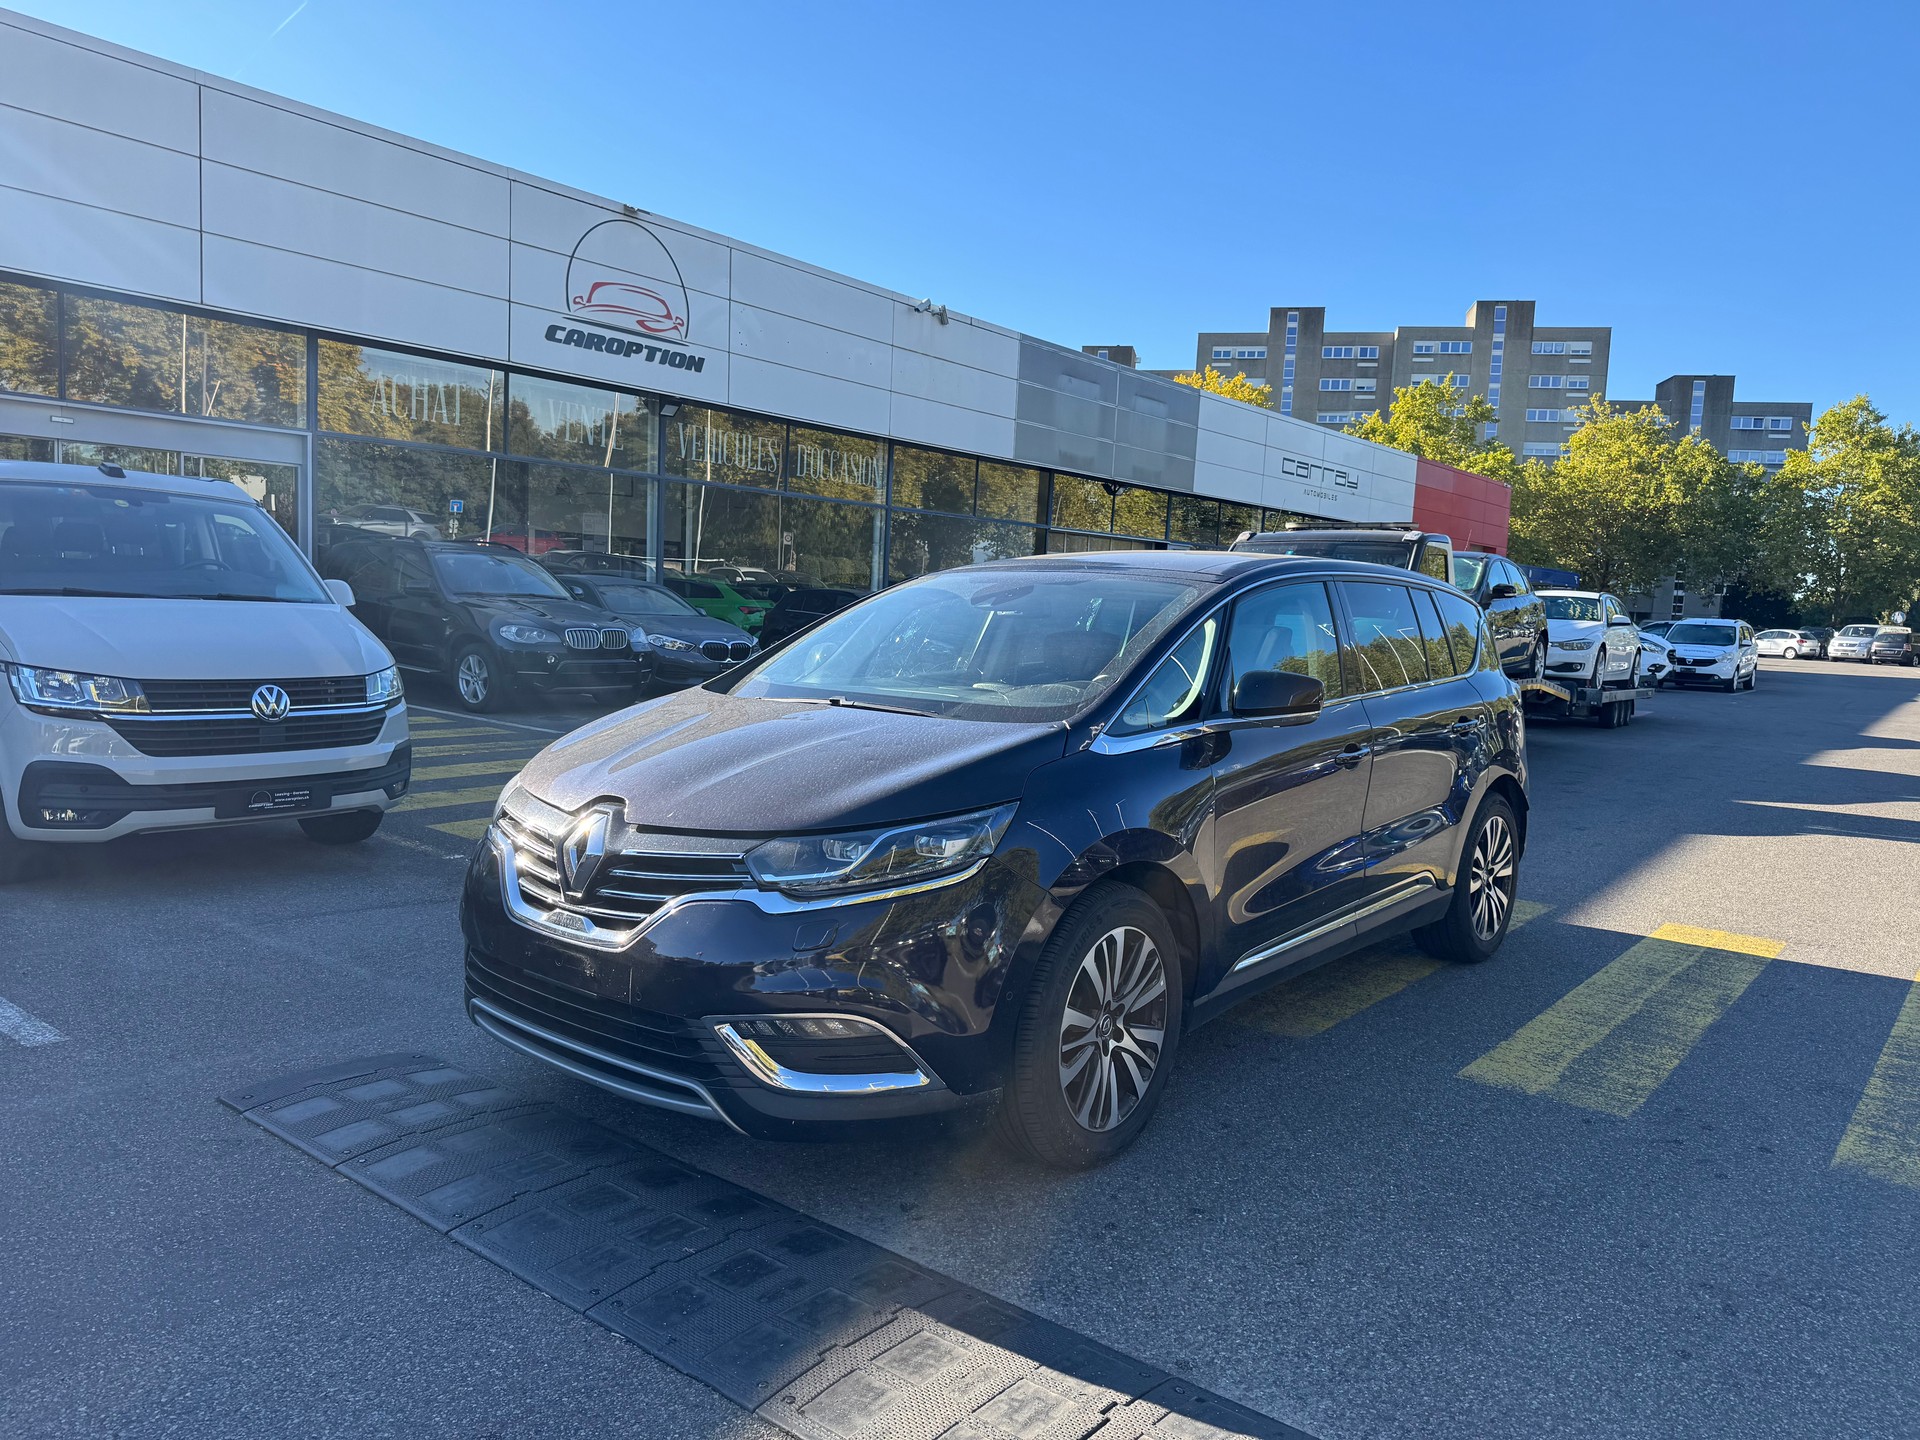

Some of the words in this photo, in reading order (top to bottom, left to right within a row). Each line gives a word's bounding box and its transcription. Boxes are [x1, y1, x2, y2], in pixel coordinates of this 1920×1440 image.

[545, 324, 705, 373] CAROPTION
[370, 371, 466, 425] ACHAT
[547, 398, 623, 450] VENTE
[678, 422, 777, 472] VEHICULES
[796, 444, 883, 490] D'OCCASION
[1281, 457, 1359, 489] carray
[1303, 489, 1338, 501] AUTOMOBILES
